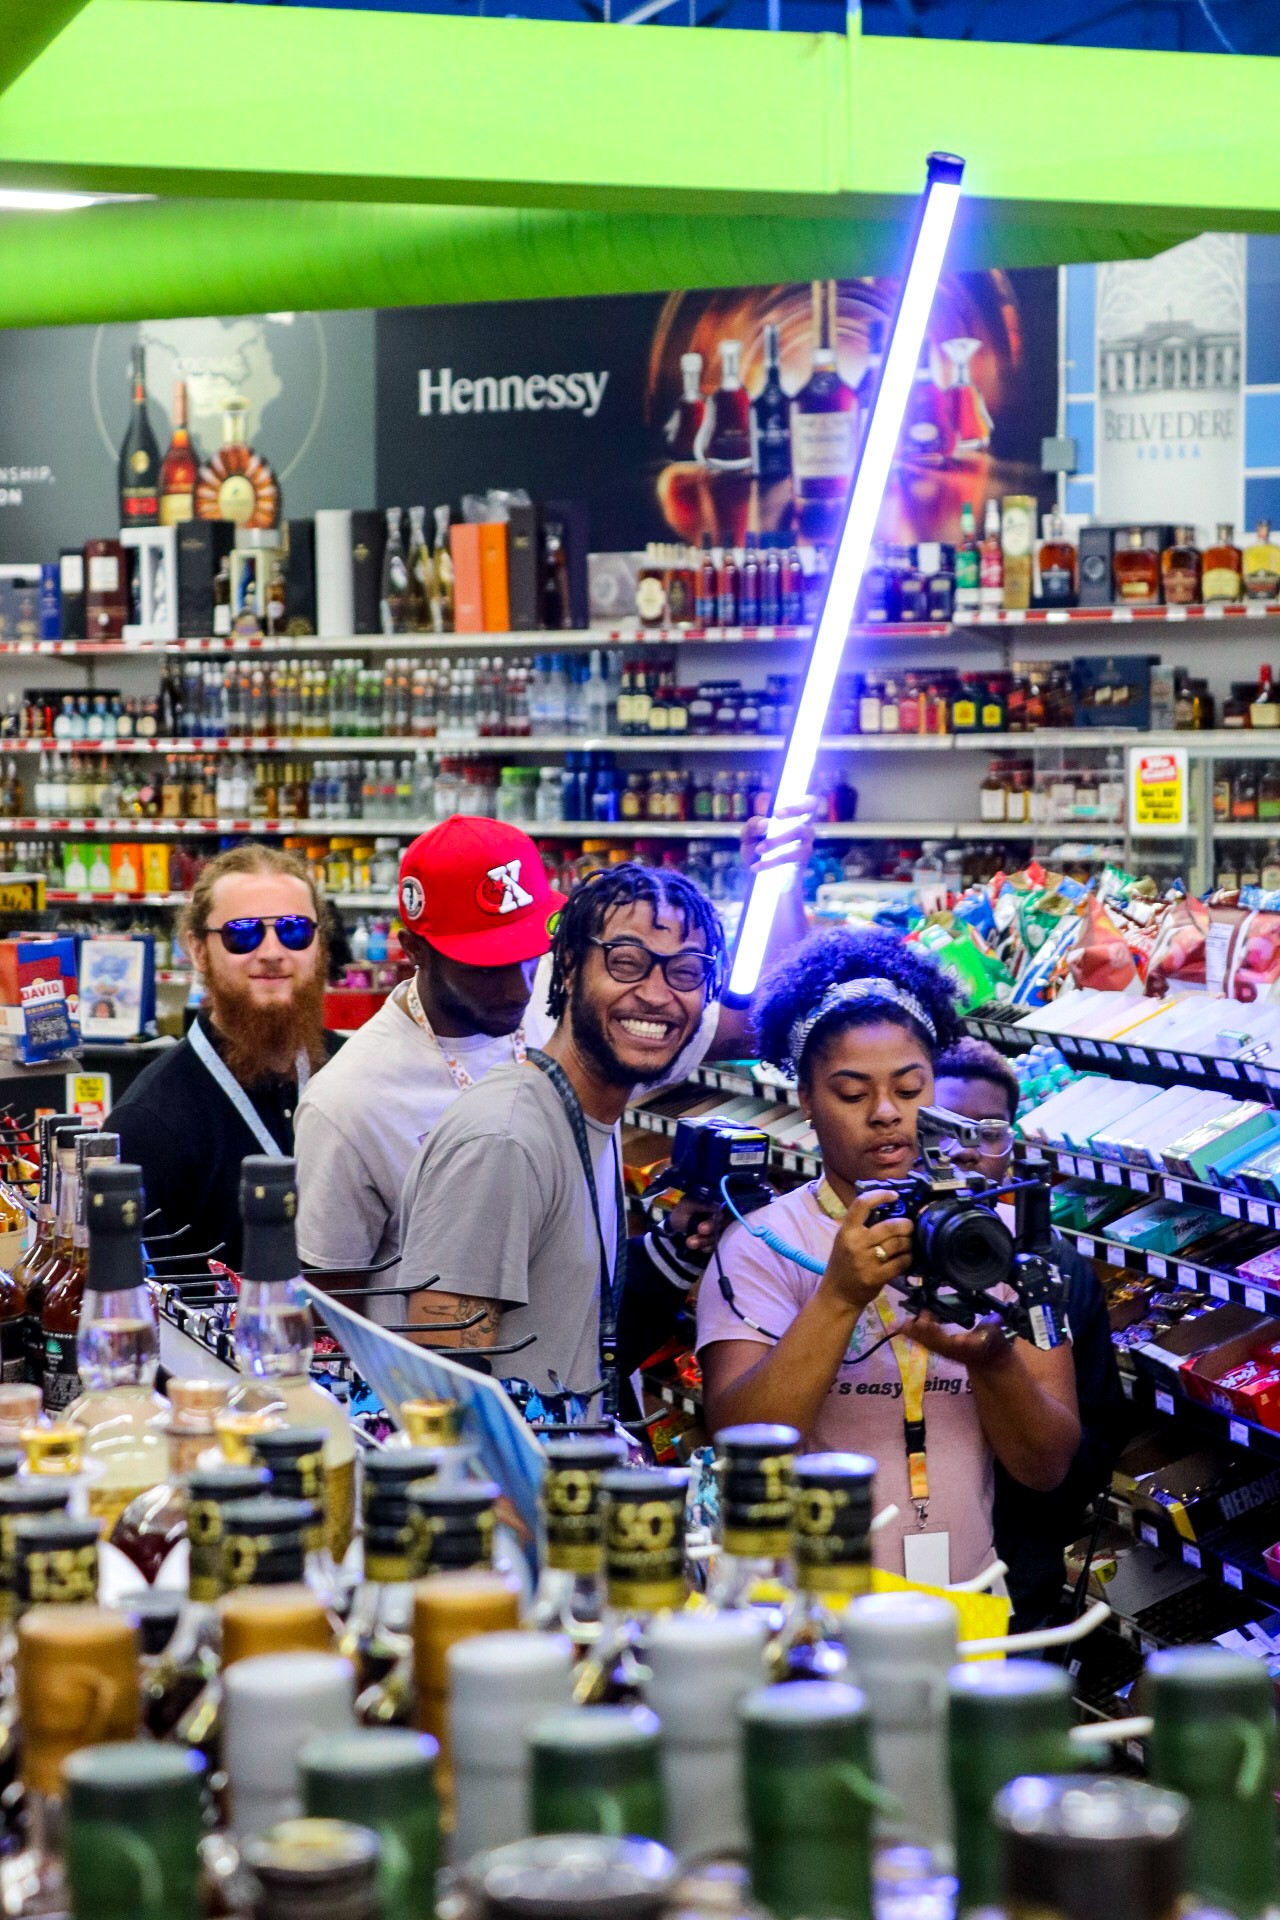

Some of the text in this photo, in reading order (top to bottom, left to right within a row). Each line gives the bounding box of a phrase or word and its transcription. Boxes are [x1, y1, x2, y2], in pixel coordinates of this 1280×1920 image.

[418, 367, 609, 418] Hennessy
[1103, 408, 1234, 441] BELVEDERE
[22, 984, 60, 1000] DAVID
[856, 1382, 903, 1399] easy
[924, 1376, 962, 1395] eing
